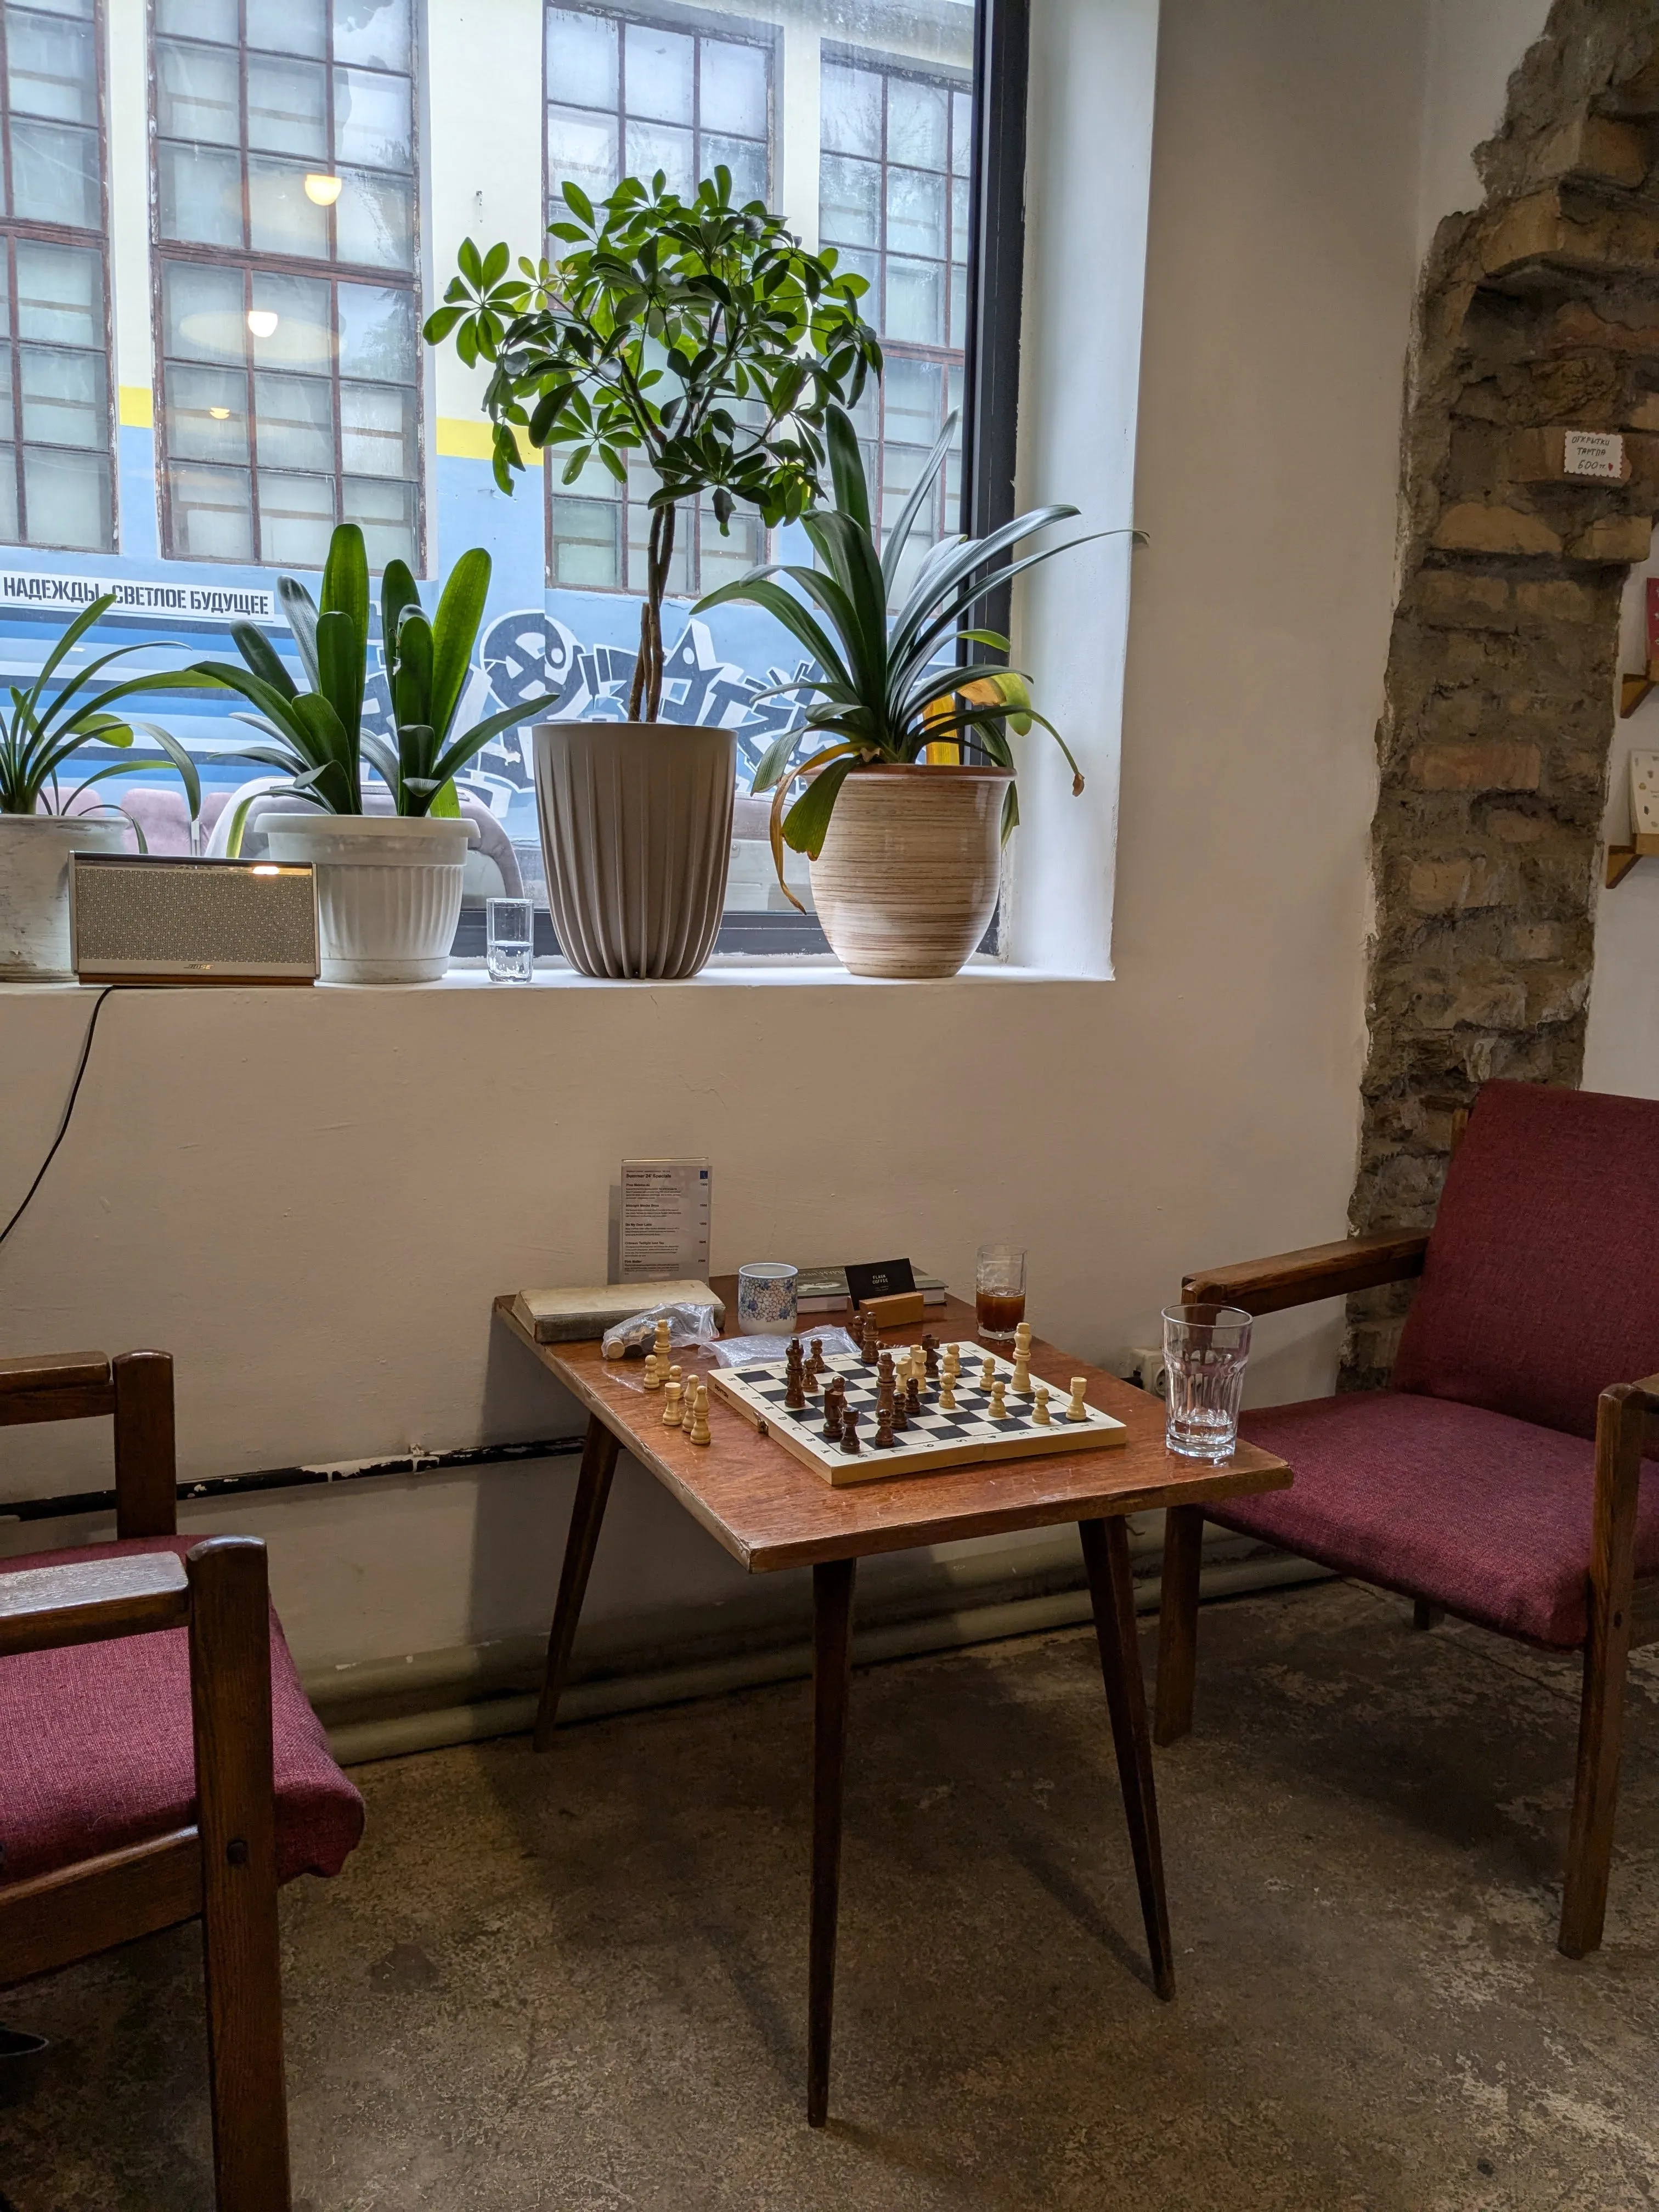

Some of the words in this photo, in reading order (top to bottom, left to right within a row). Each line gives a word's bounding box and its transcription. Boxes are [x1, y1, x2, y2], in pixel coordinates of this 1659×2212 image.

[3, 577, 100, 603] НАДЕЖДЫ
[112, 584, 187, 609] СВЕТЛОЕ
[190, 590, 269, 616] БУДУЩЕЕ
